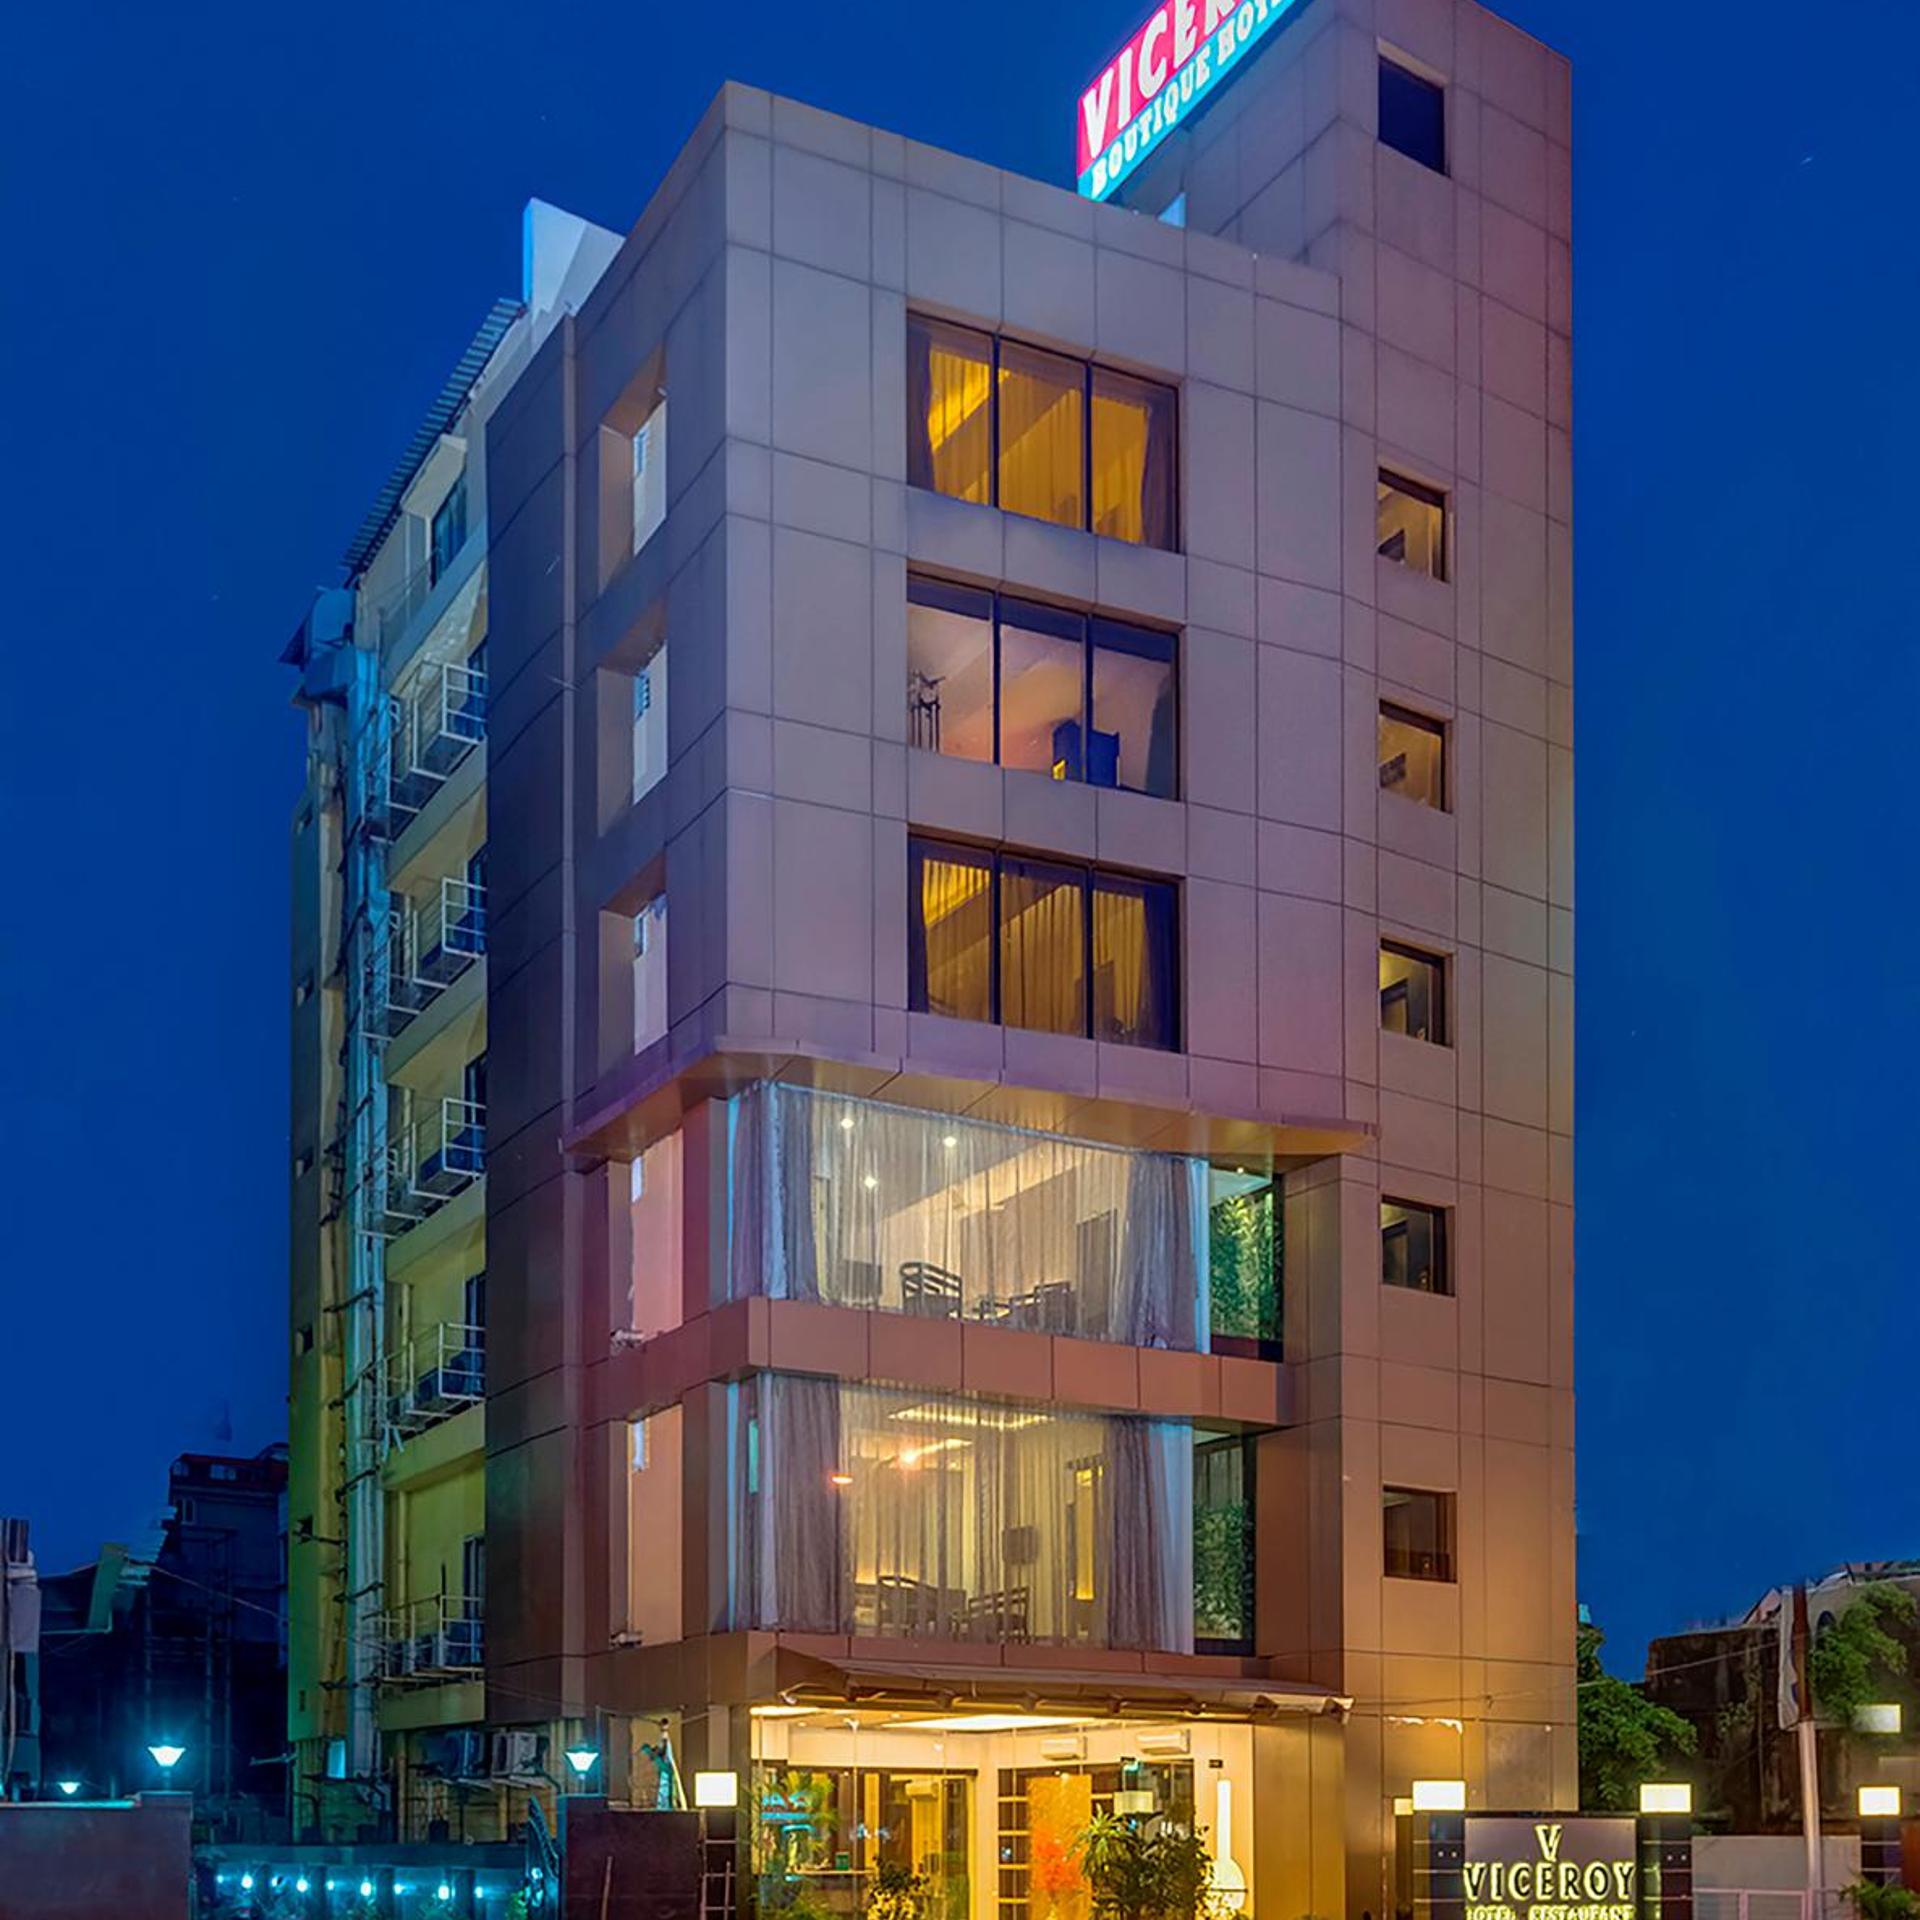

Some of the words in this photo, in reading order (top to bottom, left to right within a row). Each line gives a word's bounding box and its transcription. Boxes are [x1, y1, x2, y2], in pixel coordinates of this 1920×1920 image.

[1091, 45, 1211, 200] BOUTIQUE
[1217, 0, 1281, 66] HOT
[1463, 1862, 1636, 1901] VICEROY
